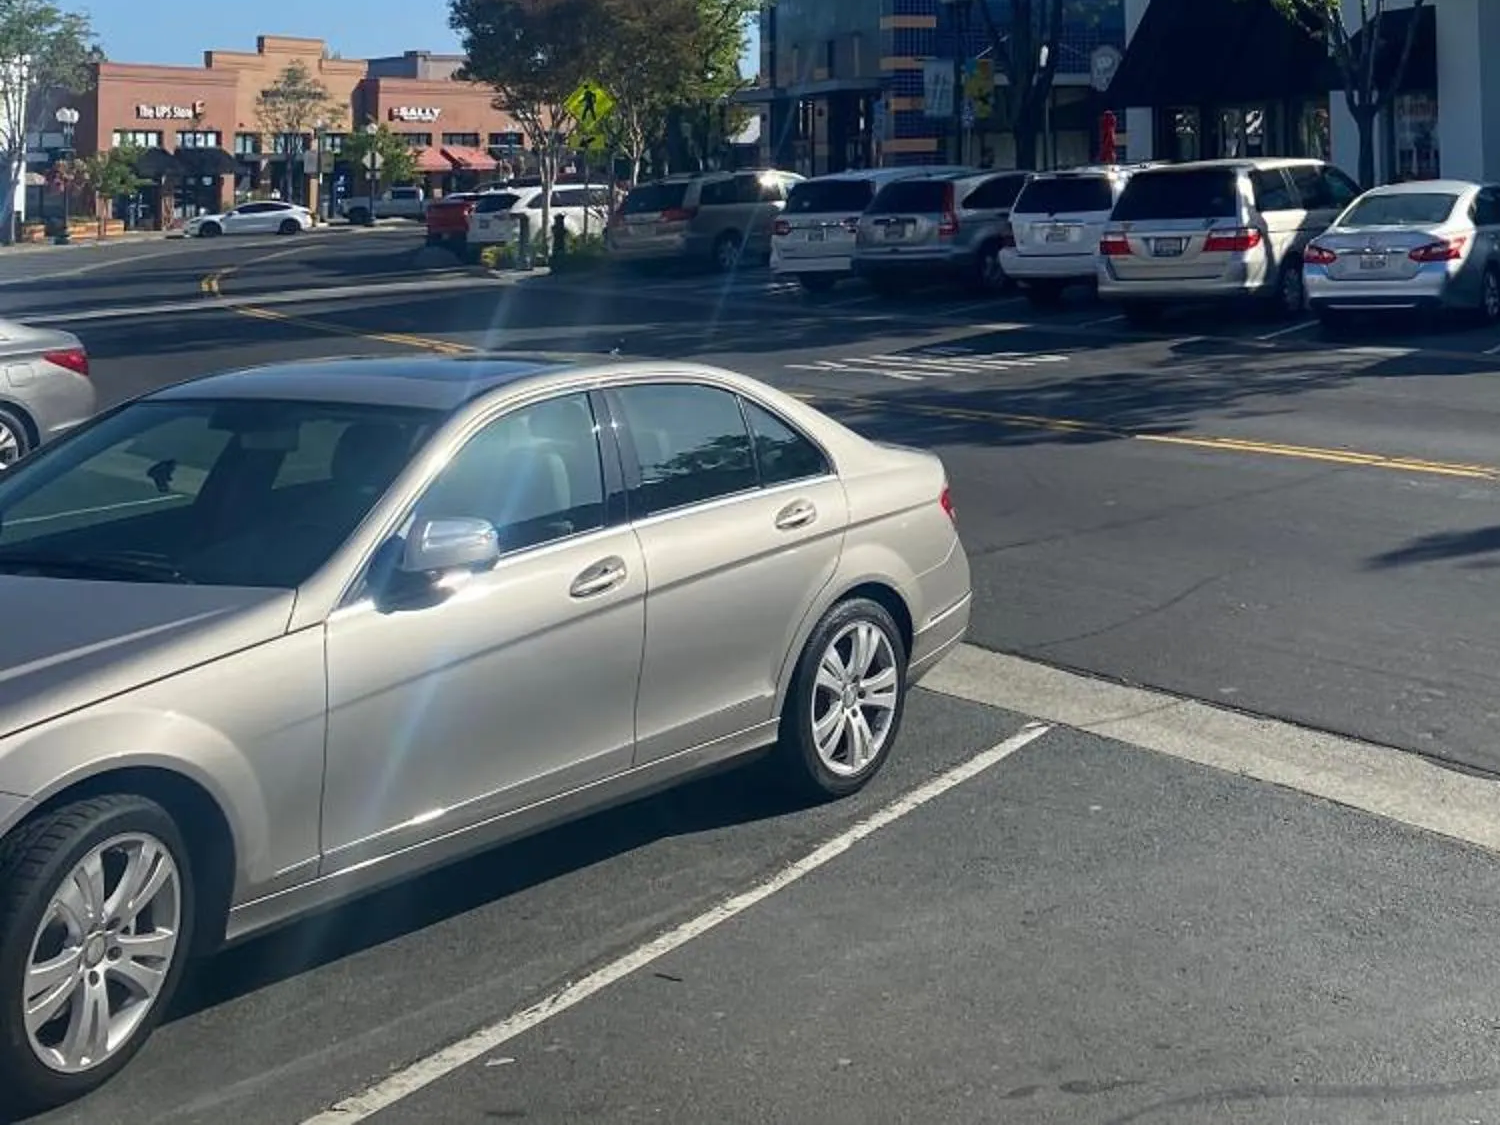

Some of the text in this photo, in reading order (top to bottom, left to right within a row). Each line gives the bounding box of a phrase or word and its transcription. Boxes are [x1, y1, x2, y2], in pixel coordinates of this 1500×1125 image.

[139, 104, 193, 118] The UPS Store
